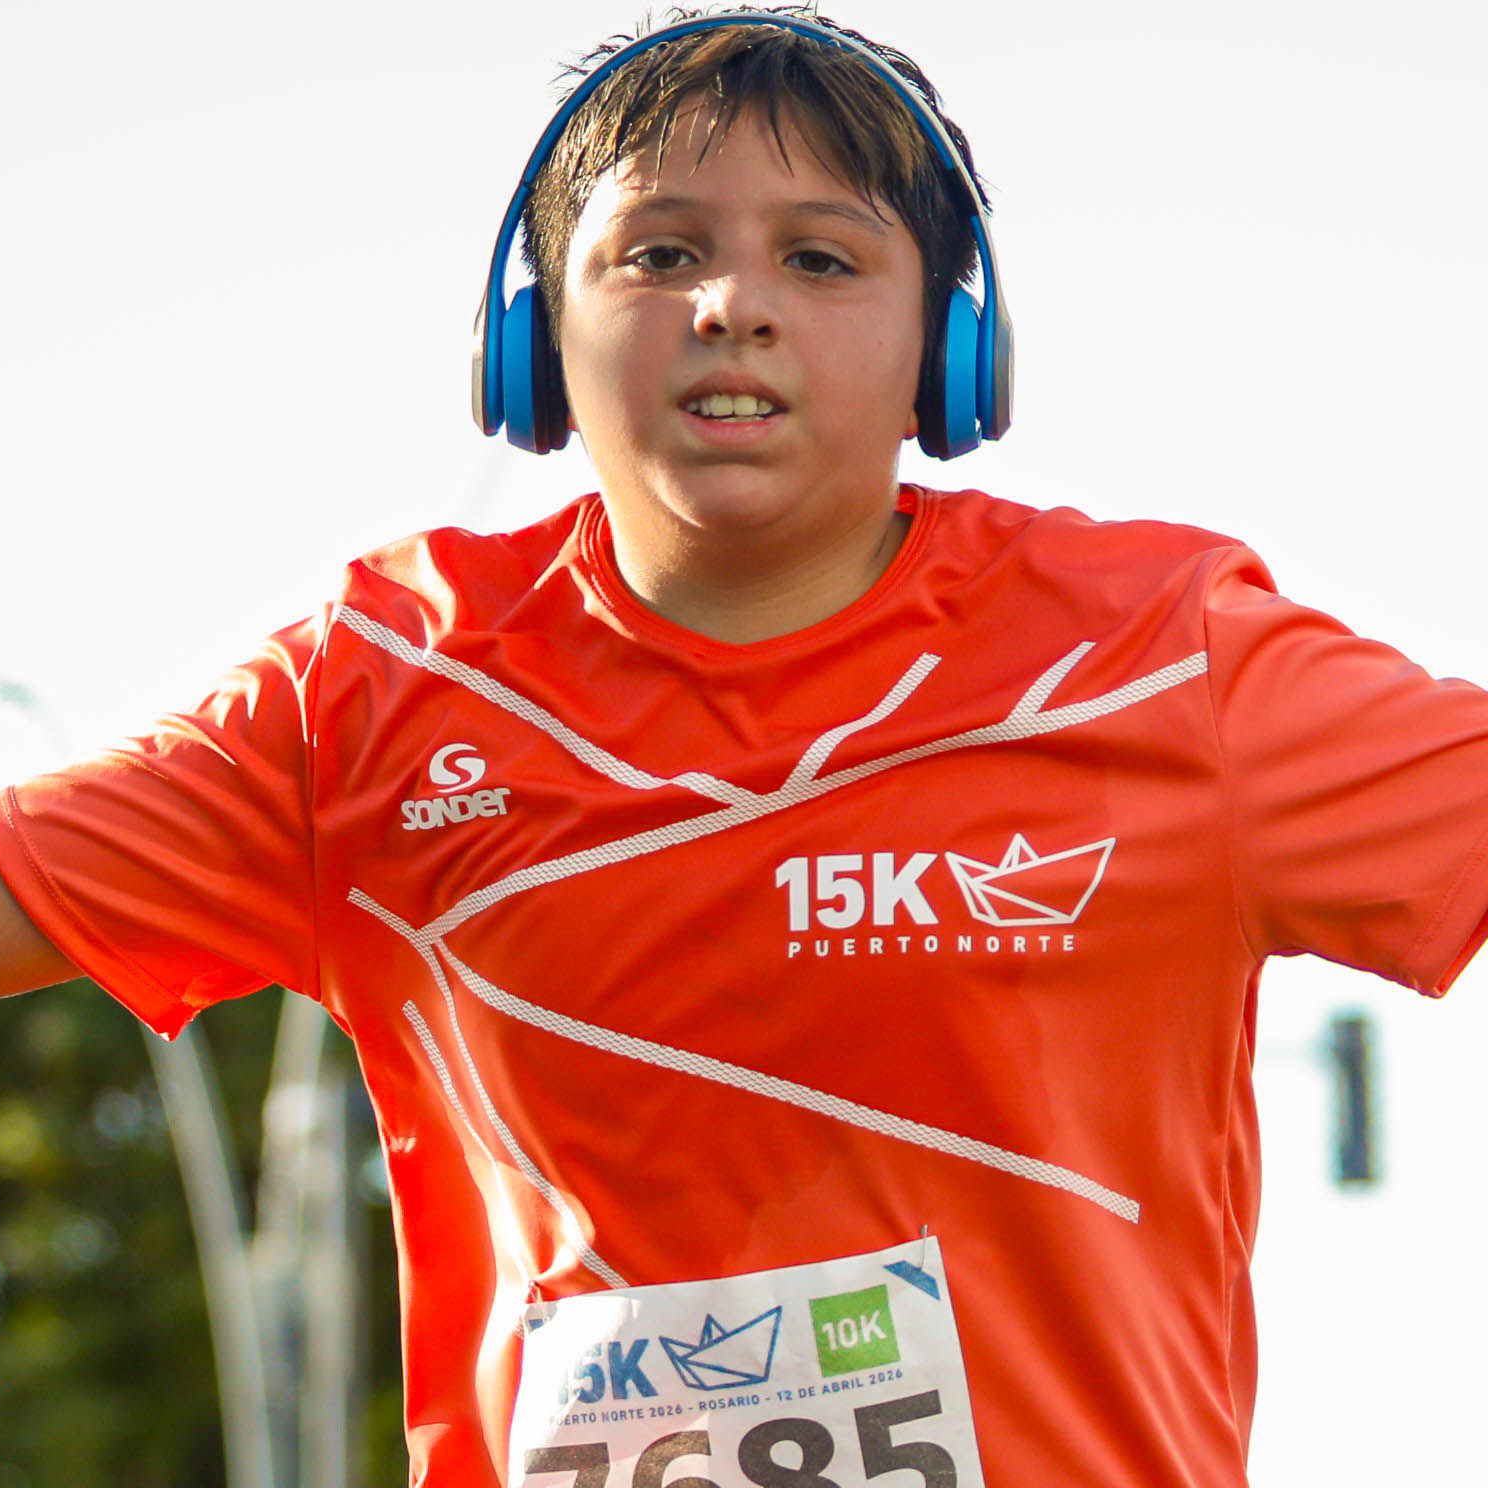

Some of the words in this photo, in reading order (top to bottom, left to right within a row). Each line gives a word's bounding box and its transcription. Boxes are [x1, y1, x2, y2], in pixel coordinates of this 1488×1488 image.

[775, 852, 939, 931] 15K
[788, 935, 939, 958] PUERTO
[958, 935, 1074, 952] NORTE
[821, 1310, 888, 1351] 10K
[601, 1408, 644, 1423] NORTE
[649, 1403, 683, 1418] 2026
[699, 1394, 760, 1411] ROSARIO
[776, 1390, 793, 1401] 12
[798, 1386, 816, 1398] DE
[821, 1377, 864, 1394] ABRIL
[869, 1368, 903, 1385] 2026
